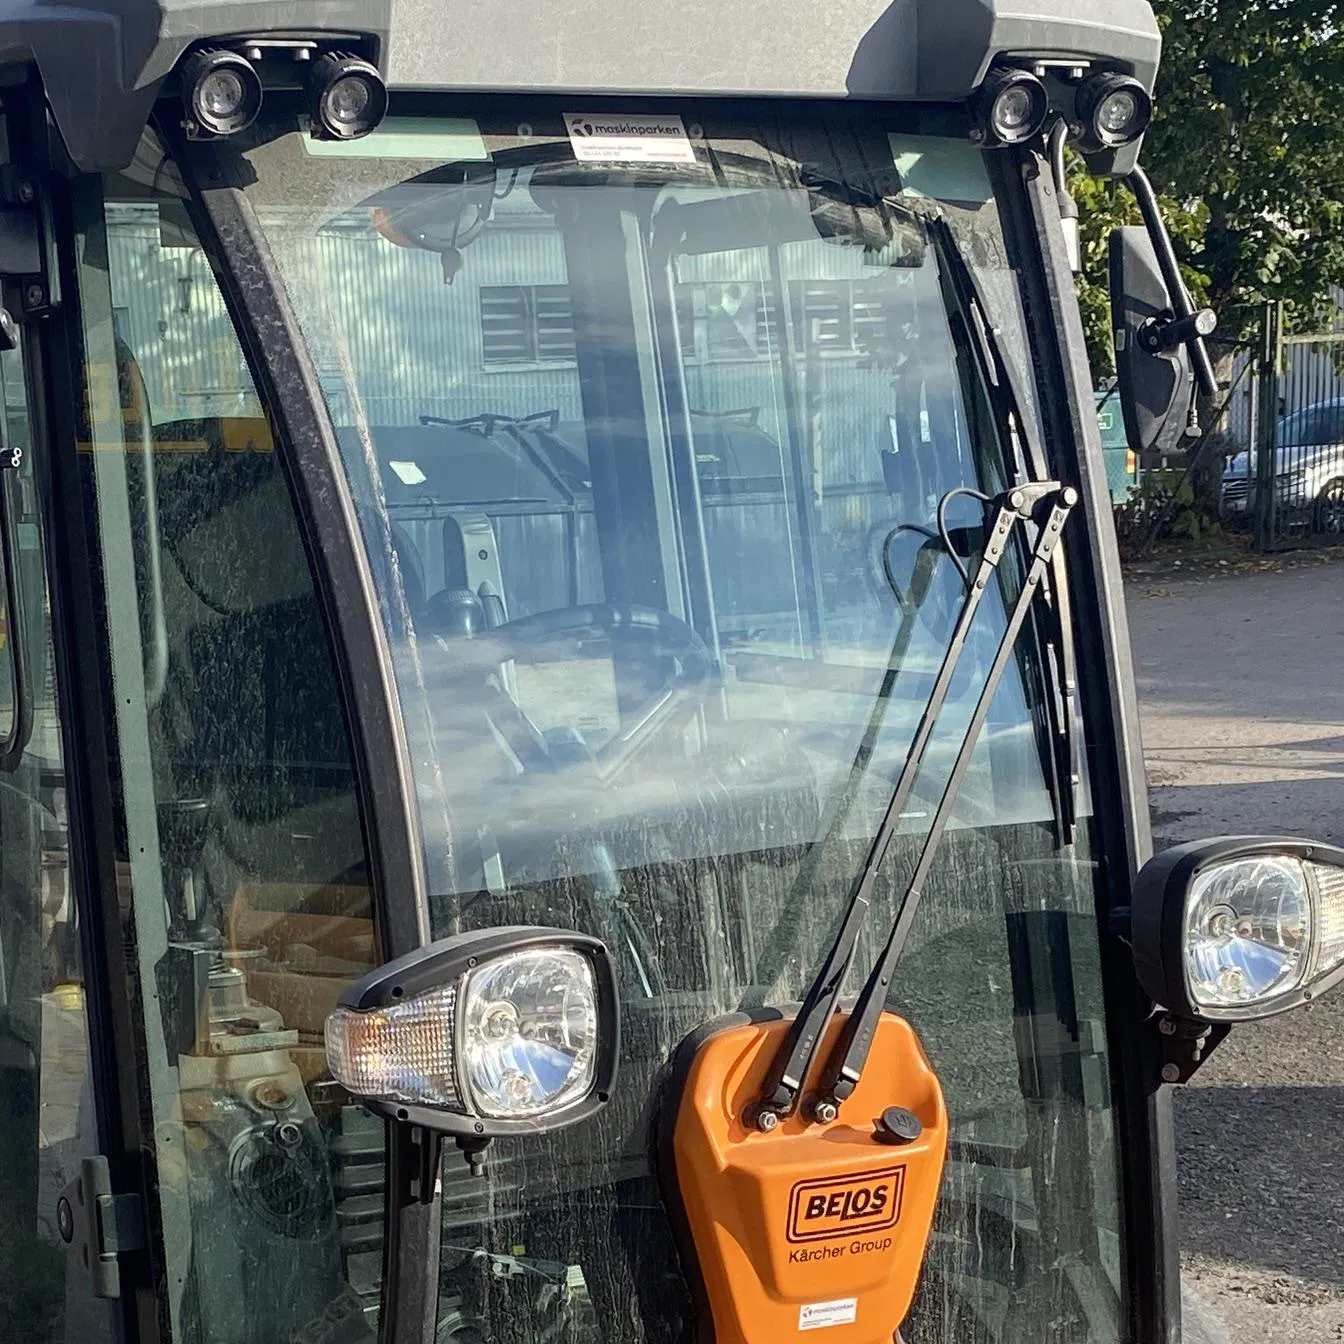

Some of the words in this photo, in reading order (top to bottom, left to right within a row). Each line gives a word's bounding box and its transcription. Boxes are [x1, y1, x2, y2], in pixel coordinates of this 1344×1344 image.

[595, 123, 681, 136] maskinparken
[805, 1184, 889, 1222] BELOS
[788, 1246, 846, 1264] Kärcher
[849, 1237, 892, 1254] Group
